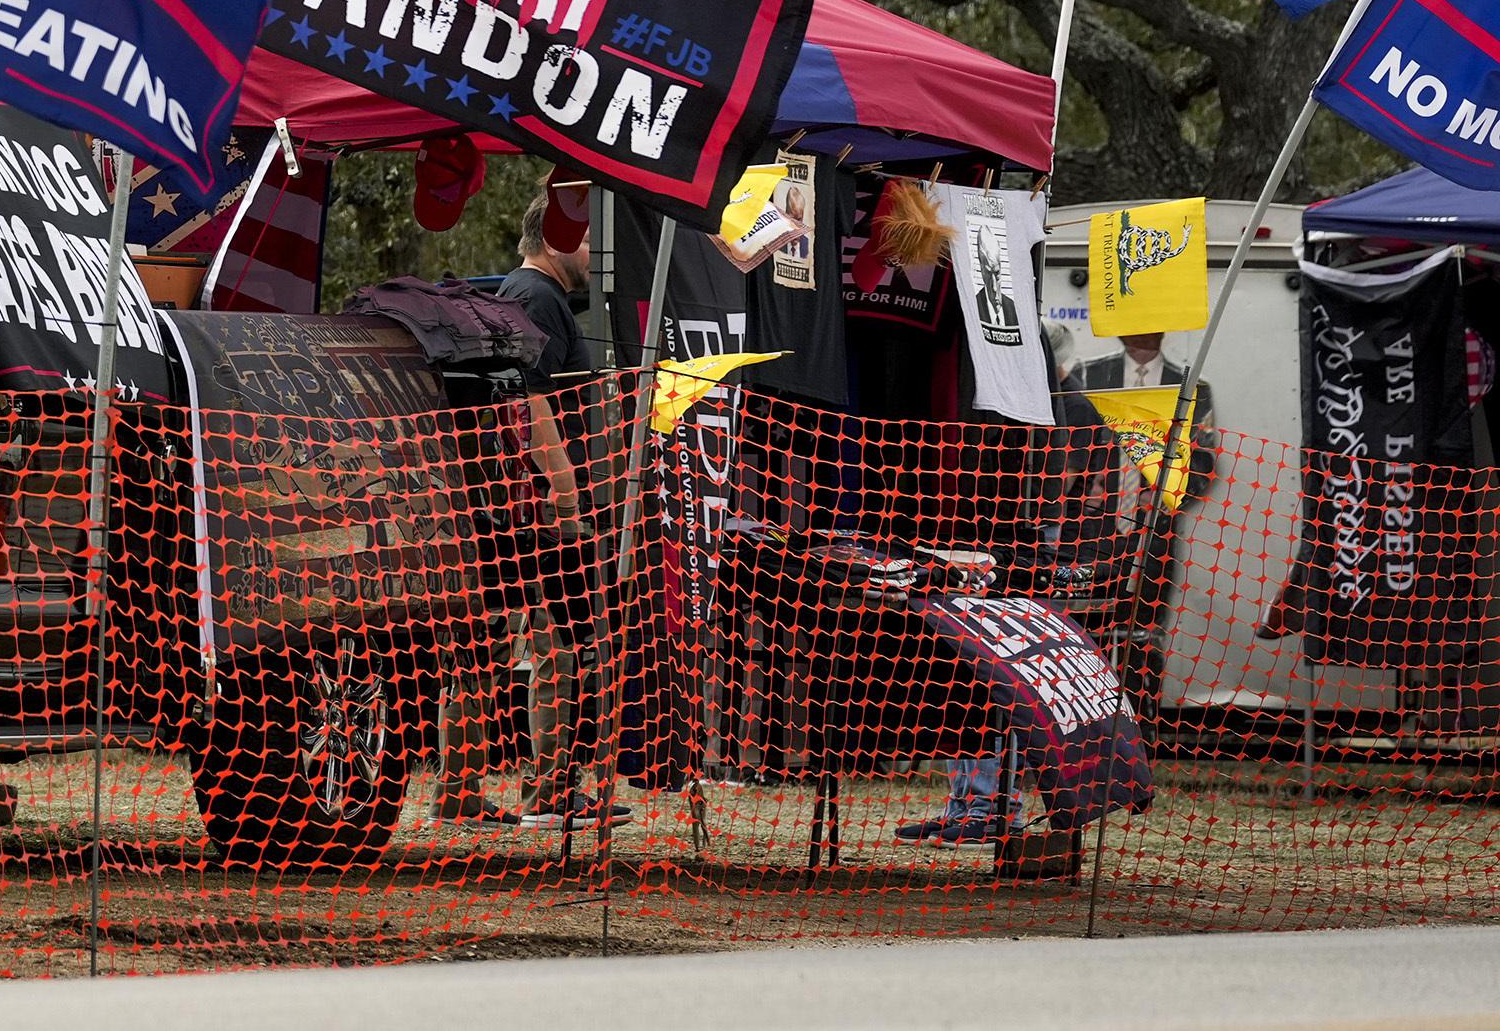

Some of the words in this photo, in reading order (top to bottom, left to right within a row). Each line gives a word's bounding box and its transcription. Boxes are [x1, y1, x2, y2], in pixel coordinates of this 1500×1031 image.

[609, 12, 714, 78] #FJB
[1368, 45, 1448, 118] NO
[11, 139, 108, 217] DOG
[1103, 232, 1114, 270] TREAD
[1103, 272, 1114, 290] ON
[859, 292, 891, 304] FOR
[893, 295, 928, 312] HIM!
[1105, 293, 1116, 311] ME
[663, 316, 677, 351] AND
[681, 476, 696, 542] VOTING
